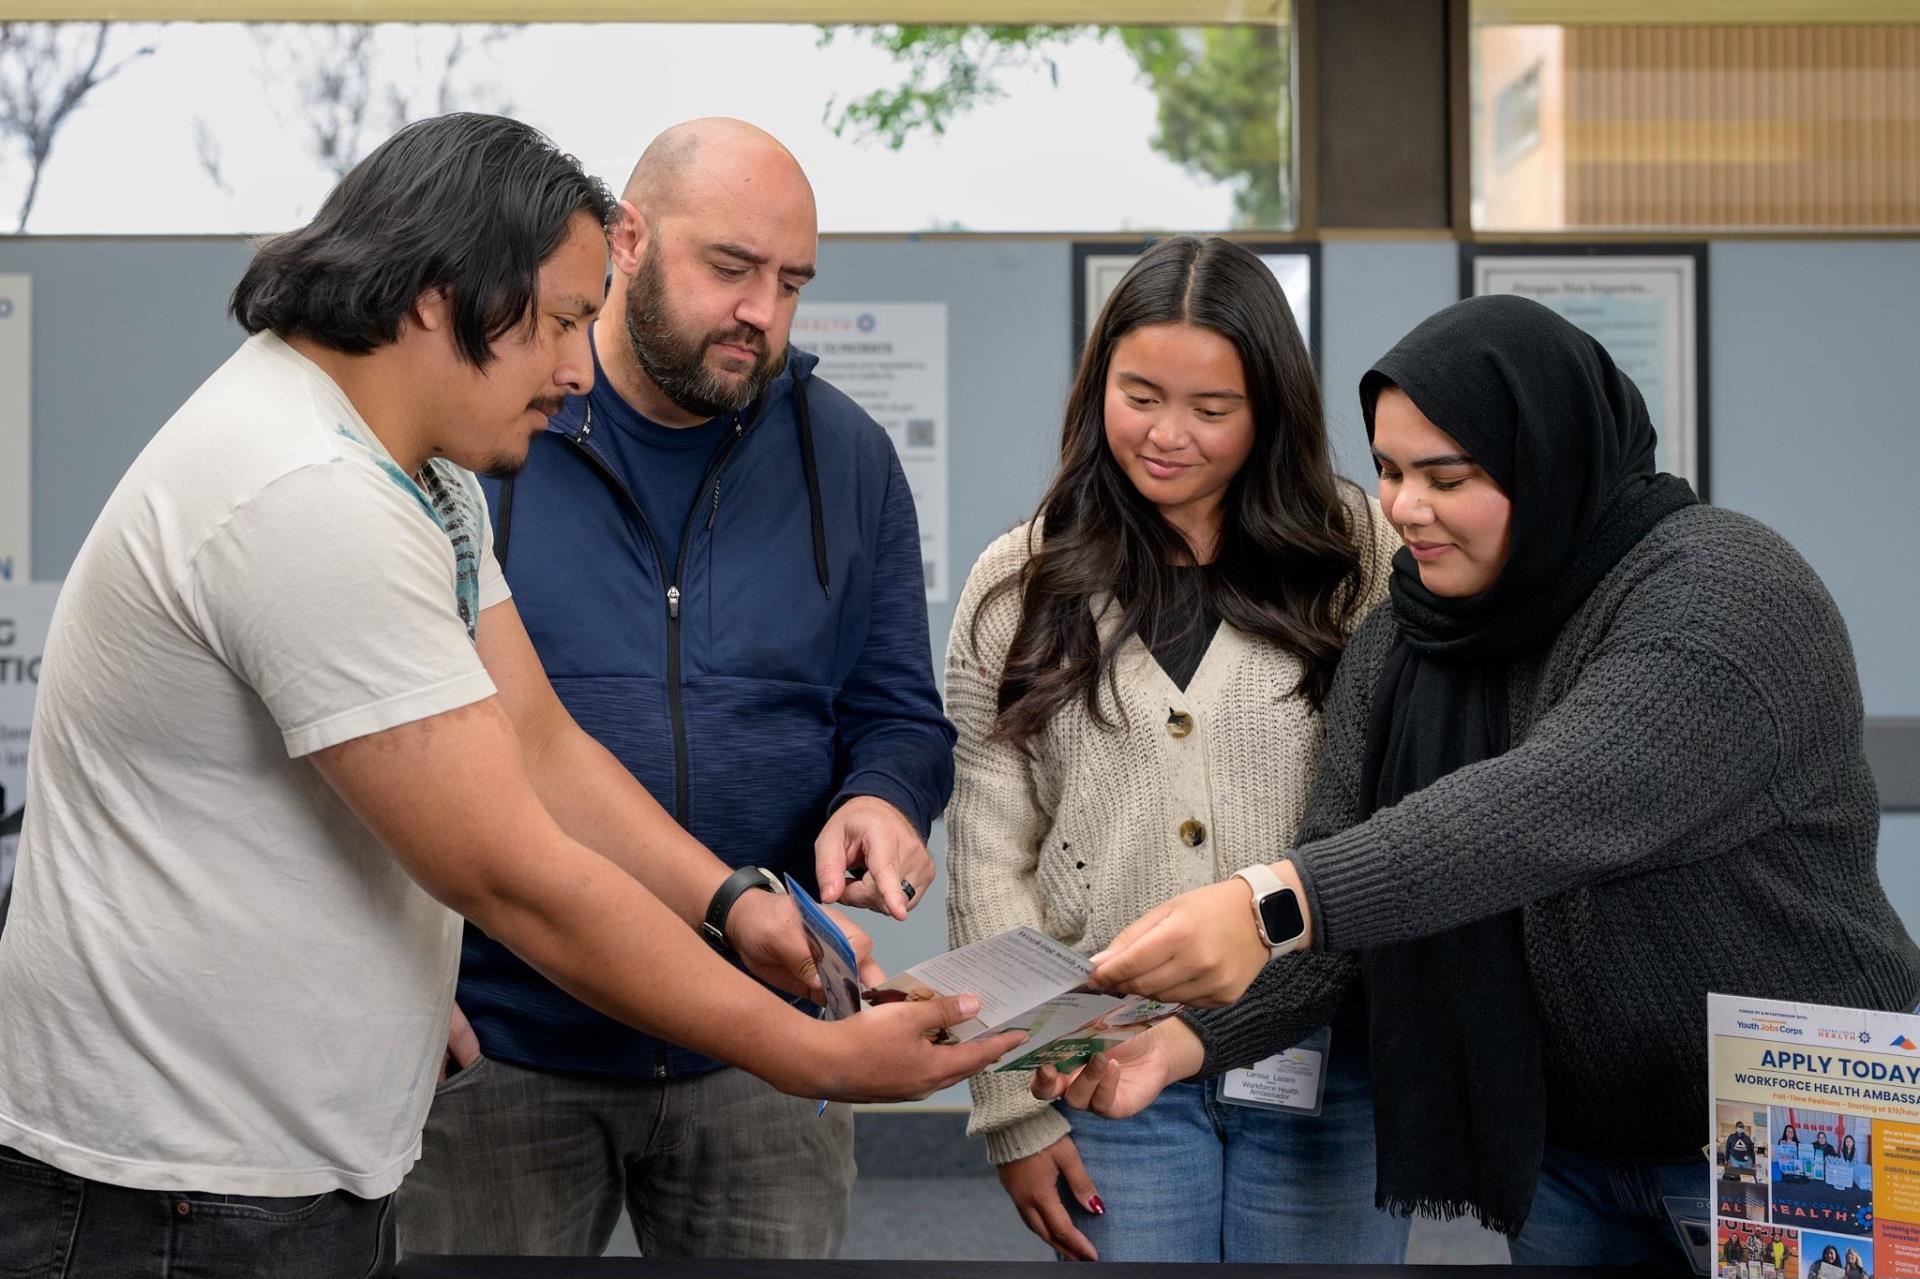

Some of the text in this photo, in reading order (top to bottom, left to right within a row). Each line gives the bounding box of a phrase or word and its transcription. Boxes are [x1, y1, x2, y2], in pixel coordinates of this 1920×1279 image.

[1737, 1021, 1759, 1030] Youth
[1760, 1024, 1779, 1033] Jobs
[1780, 1026, 1803, 1035] Corps
[1818, 1031, 1856, 1041] HEALTH
[1761, 1050, 1920, 1085] APPLY TODAY
[1243, 1081, 1300, 1096] Workforce Health
[1735, 1073, 1811, 1092] WORKFORCE
[1814, 1083, 1860, 1098] HEALTH
[1773, 1093, 1806, 1102] Full-Time
[1808, 1097, 1840, 1107] Positions
[1848, 1102, 1877, 1113] Starting
[1882, 1224, 1909, 1234] Looking
